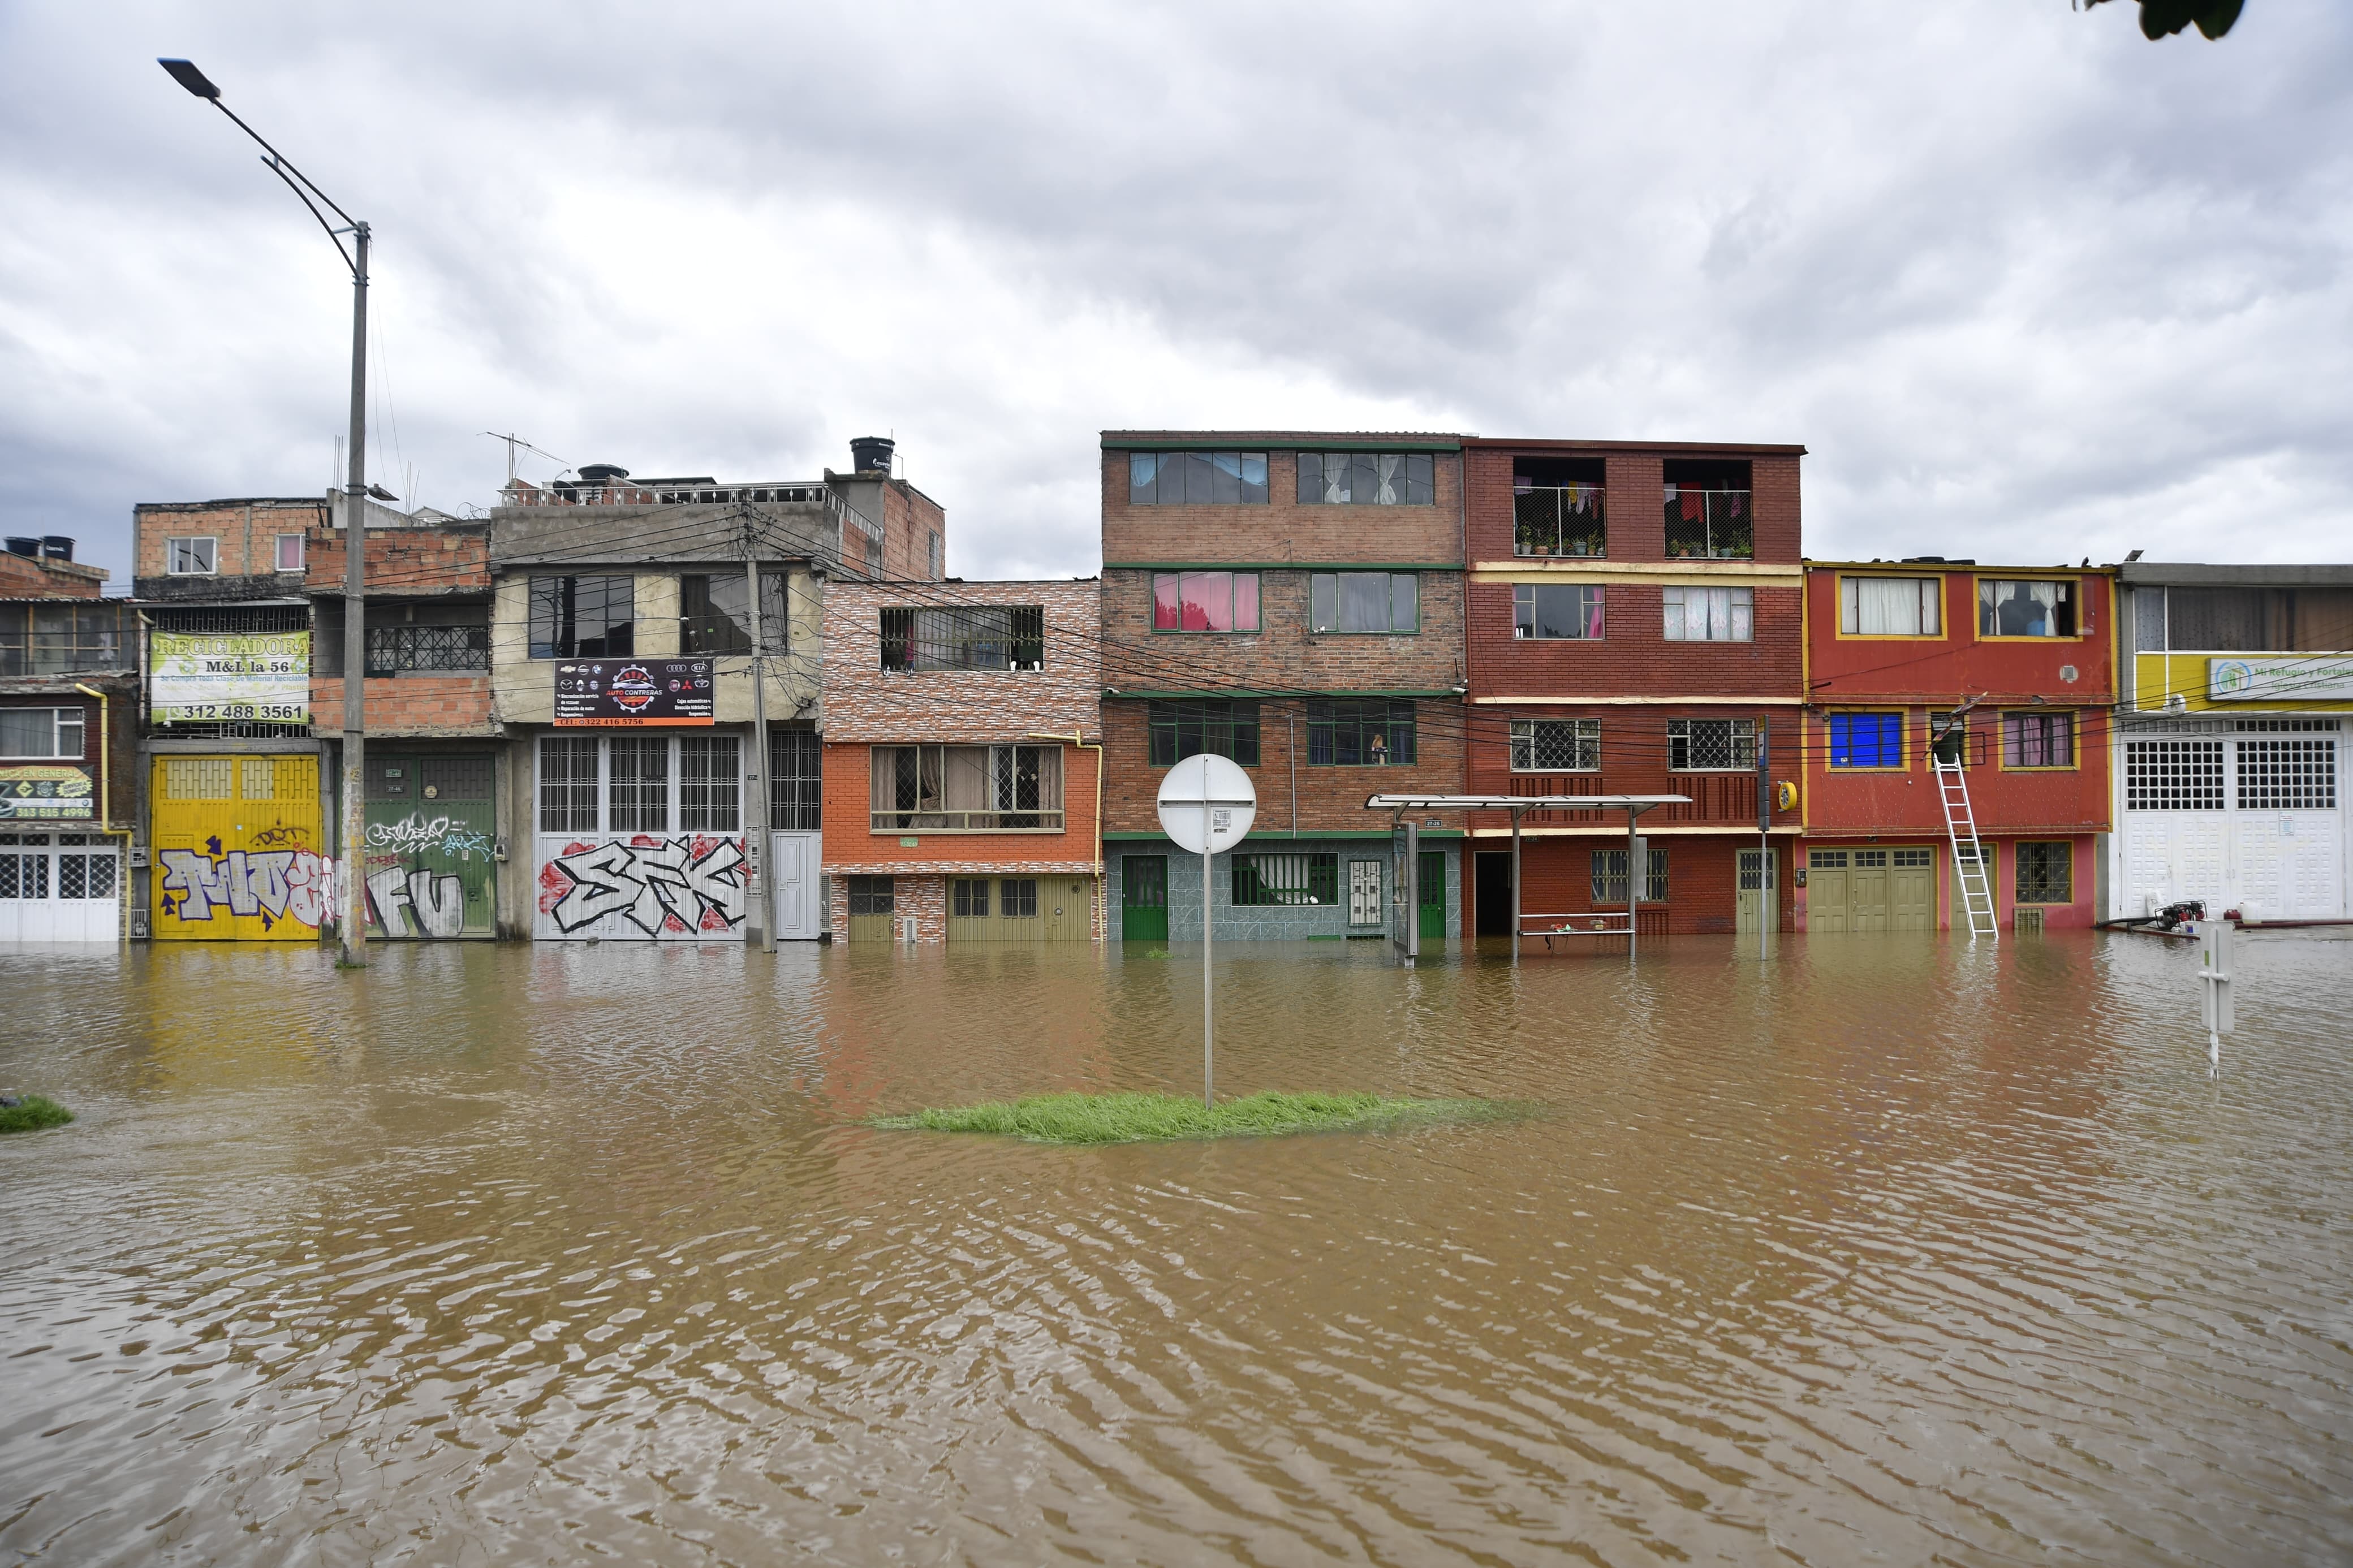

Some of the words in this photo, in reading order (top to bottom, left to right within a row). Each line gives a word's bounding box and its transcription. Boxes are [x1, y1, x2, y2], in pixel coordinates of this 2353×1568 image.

[158, 637, 309, 655] RECICLADORA
[206, 661, 244, 672] M&L
[251, 661, 265, 672] la
[270, 662, 289, 672] 56
[2255, 668, 2266, 676] Mi
[2270, 668, 2306, 677] Refugio
[184, 705, 216, 719] 312
[222, 705, 254, 719] 488
[261, 705, 302, 719] 3561
[24, 769, 35, 777] EN
[38, 769, 79, 778] GENERAL
[17, 808, 36, 818] 313
[39, 808, 59, 818] 515
[62, 808, 92, 818] 4996
